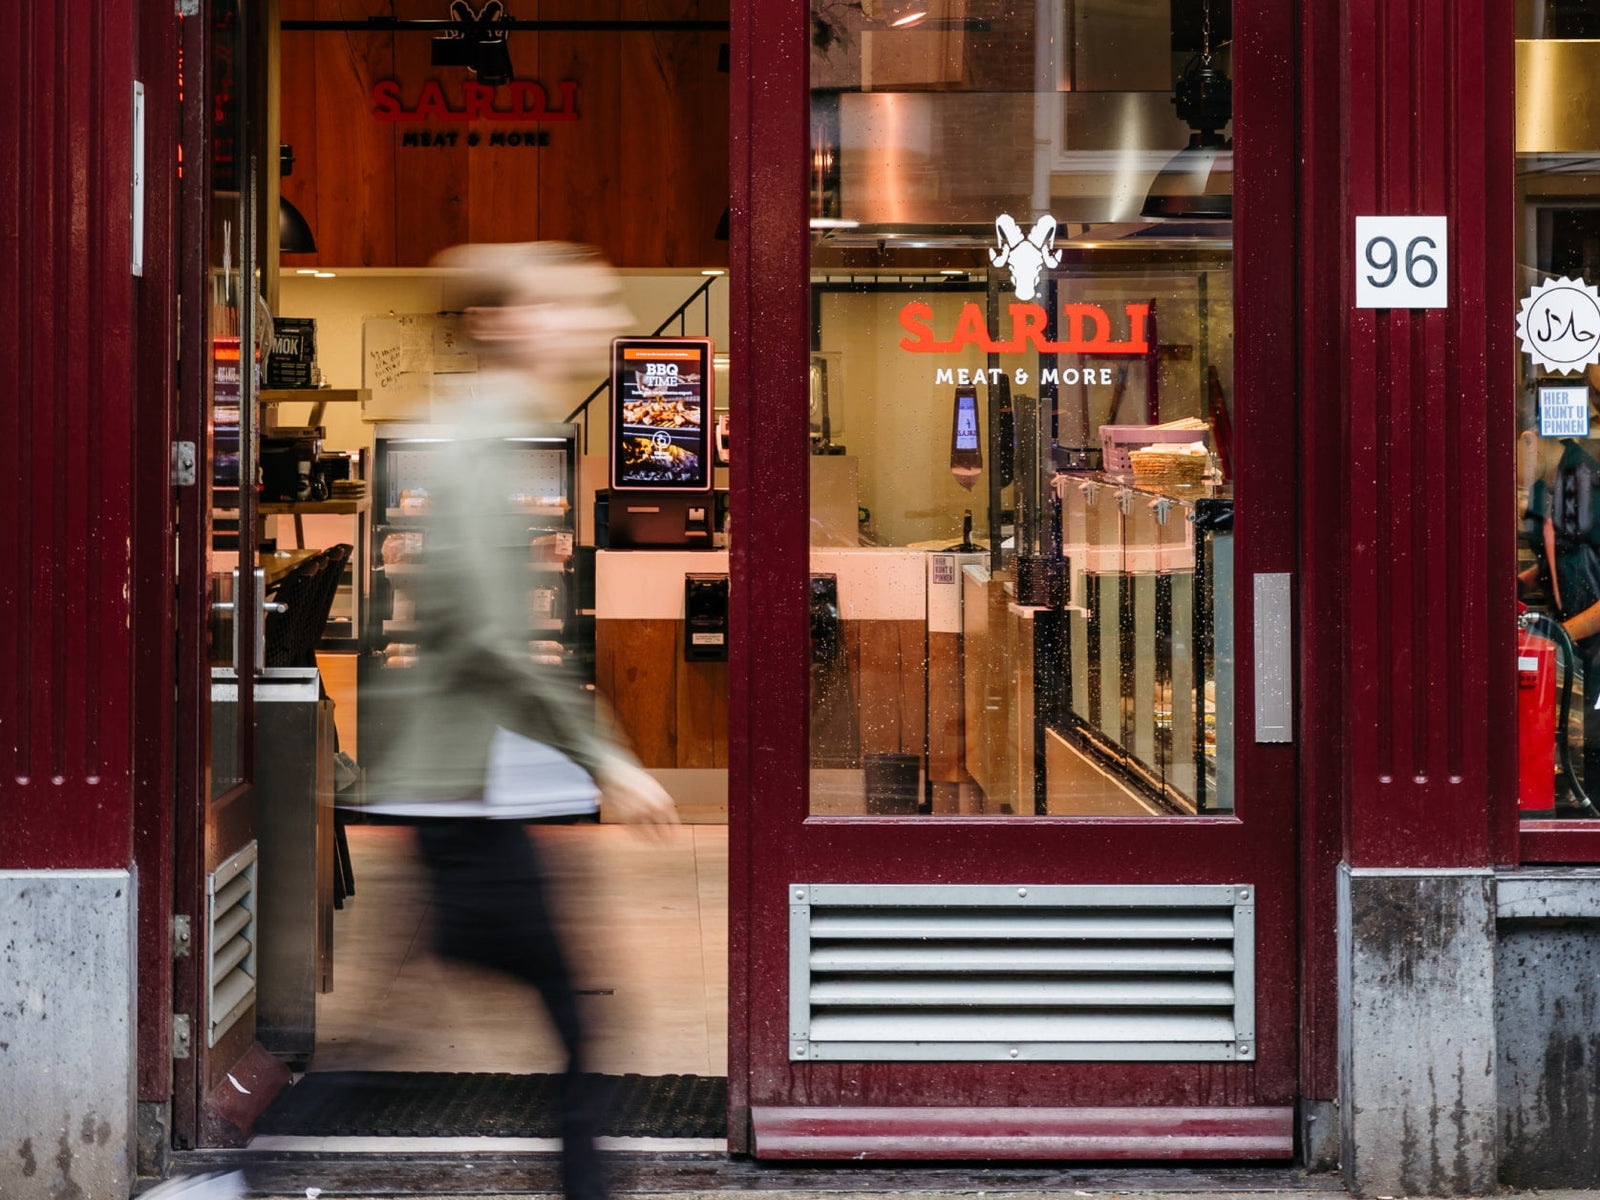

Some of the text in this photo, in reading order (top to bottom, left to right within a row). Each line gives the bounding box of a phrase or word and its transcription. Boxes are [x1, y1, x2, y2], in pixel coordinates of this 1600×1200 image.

[372, 79, 579, 121] SARDI
[402, 131, 459, 147] MEAT
[489, 131, 550, 147] MORE
[1365, 235, 1438, 288] 96
[899, 301, 1149, 354] SARDI
[645, 363, 679, 376] BBQ
[935, 368, 1112, 385] MEAT & MORE
[648, 376, 679, 387] TIME
[1543, 391, 1569, 405] HIER
[1544, 405, 1584, 419] KUNT U
[1544, 420, 1585, 433] PINNEN
